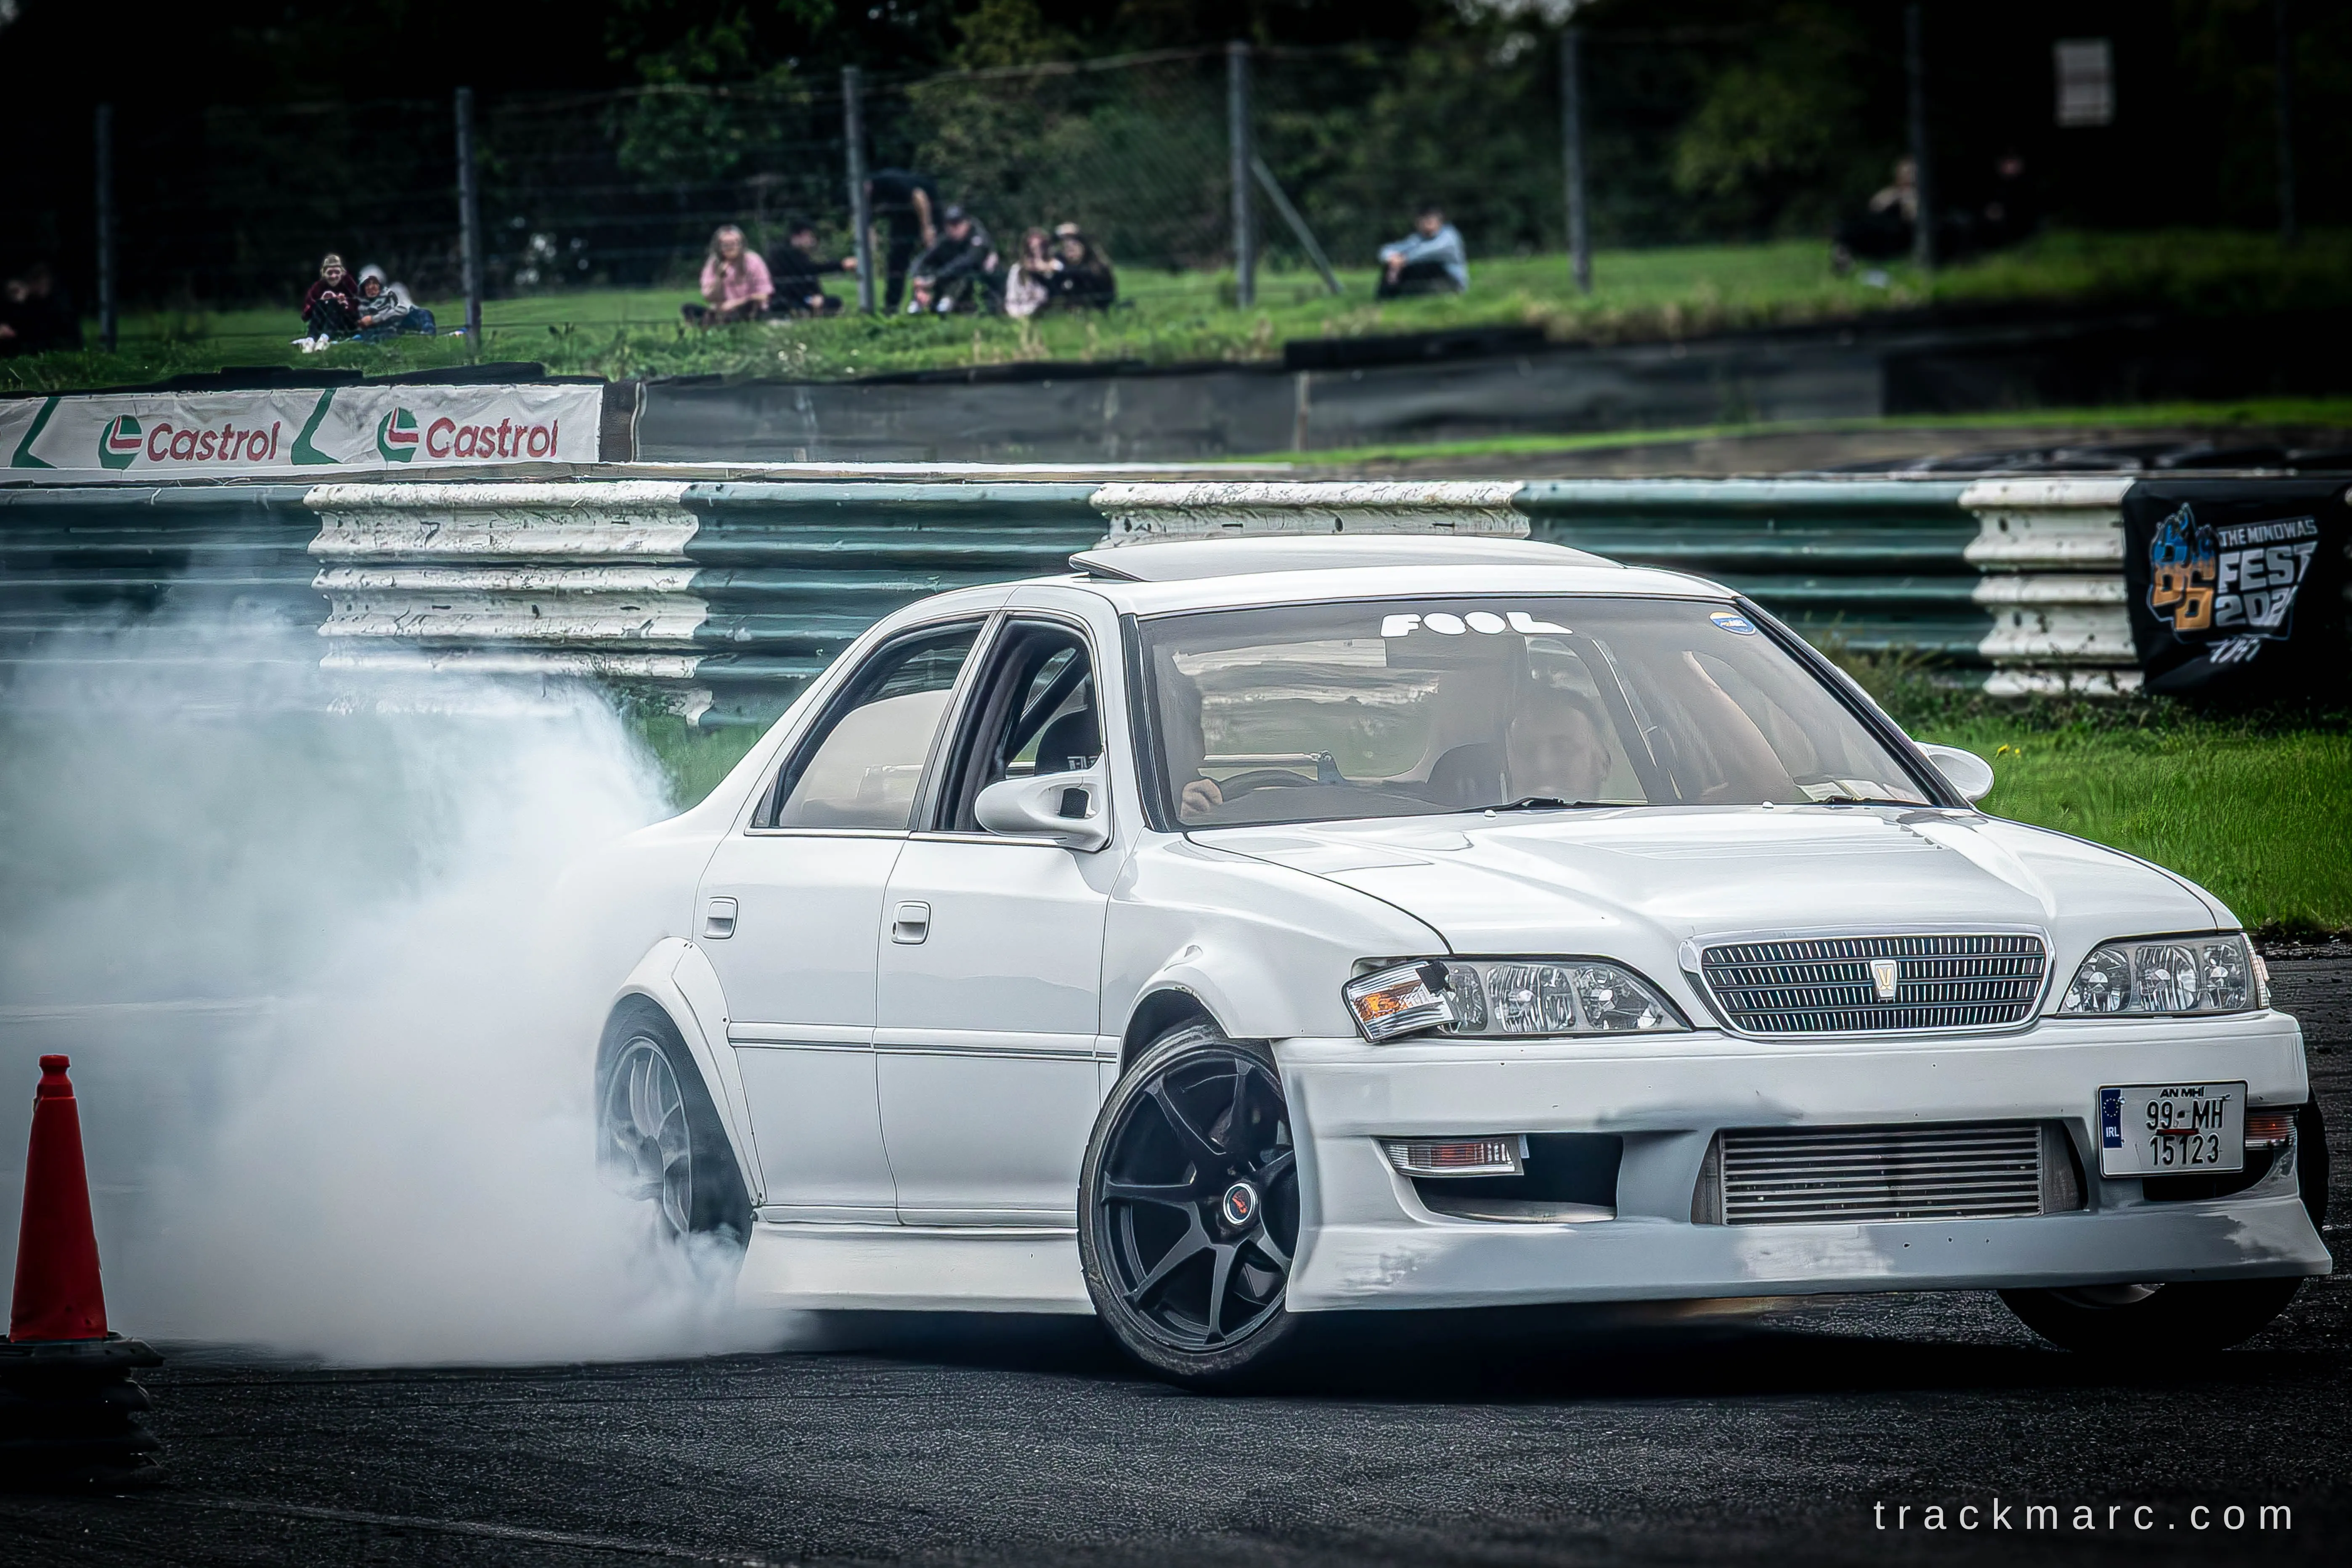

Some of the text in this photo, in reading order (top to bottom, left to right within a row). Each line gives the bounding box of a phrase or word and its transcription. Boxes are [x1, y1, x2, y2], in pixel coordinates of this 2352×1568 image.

[148, 421, 281, 462] Castrol
[425, 417, 558, 458] Castrol
[2219, 529, 2246, 547] THE
[2218, 541, 2318, 593] FEST
[1380, 611, 1573, 637] FOOL
[2160, 1088, 2179, 1098] AN
[2106, 1127, 2119, 1137] IRL
[2150, 1133, 2219, 1166] 15123
